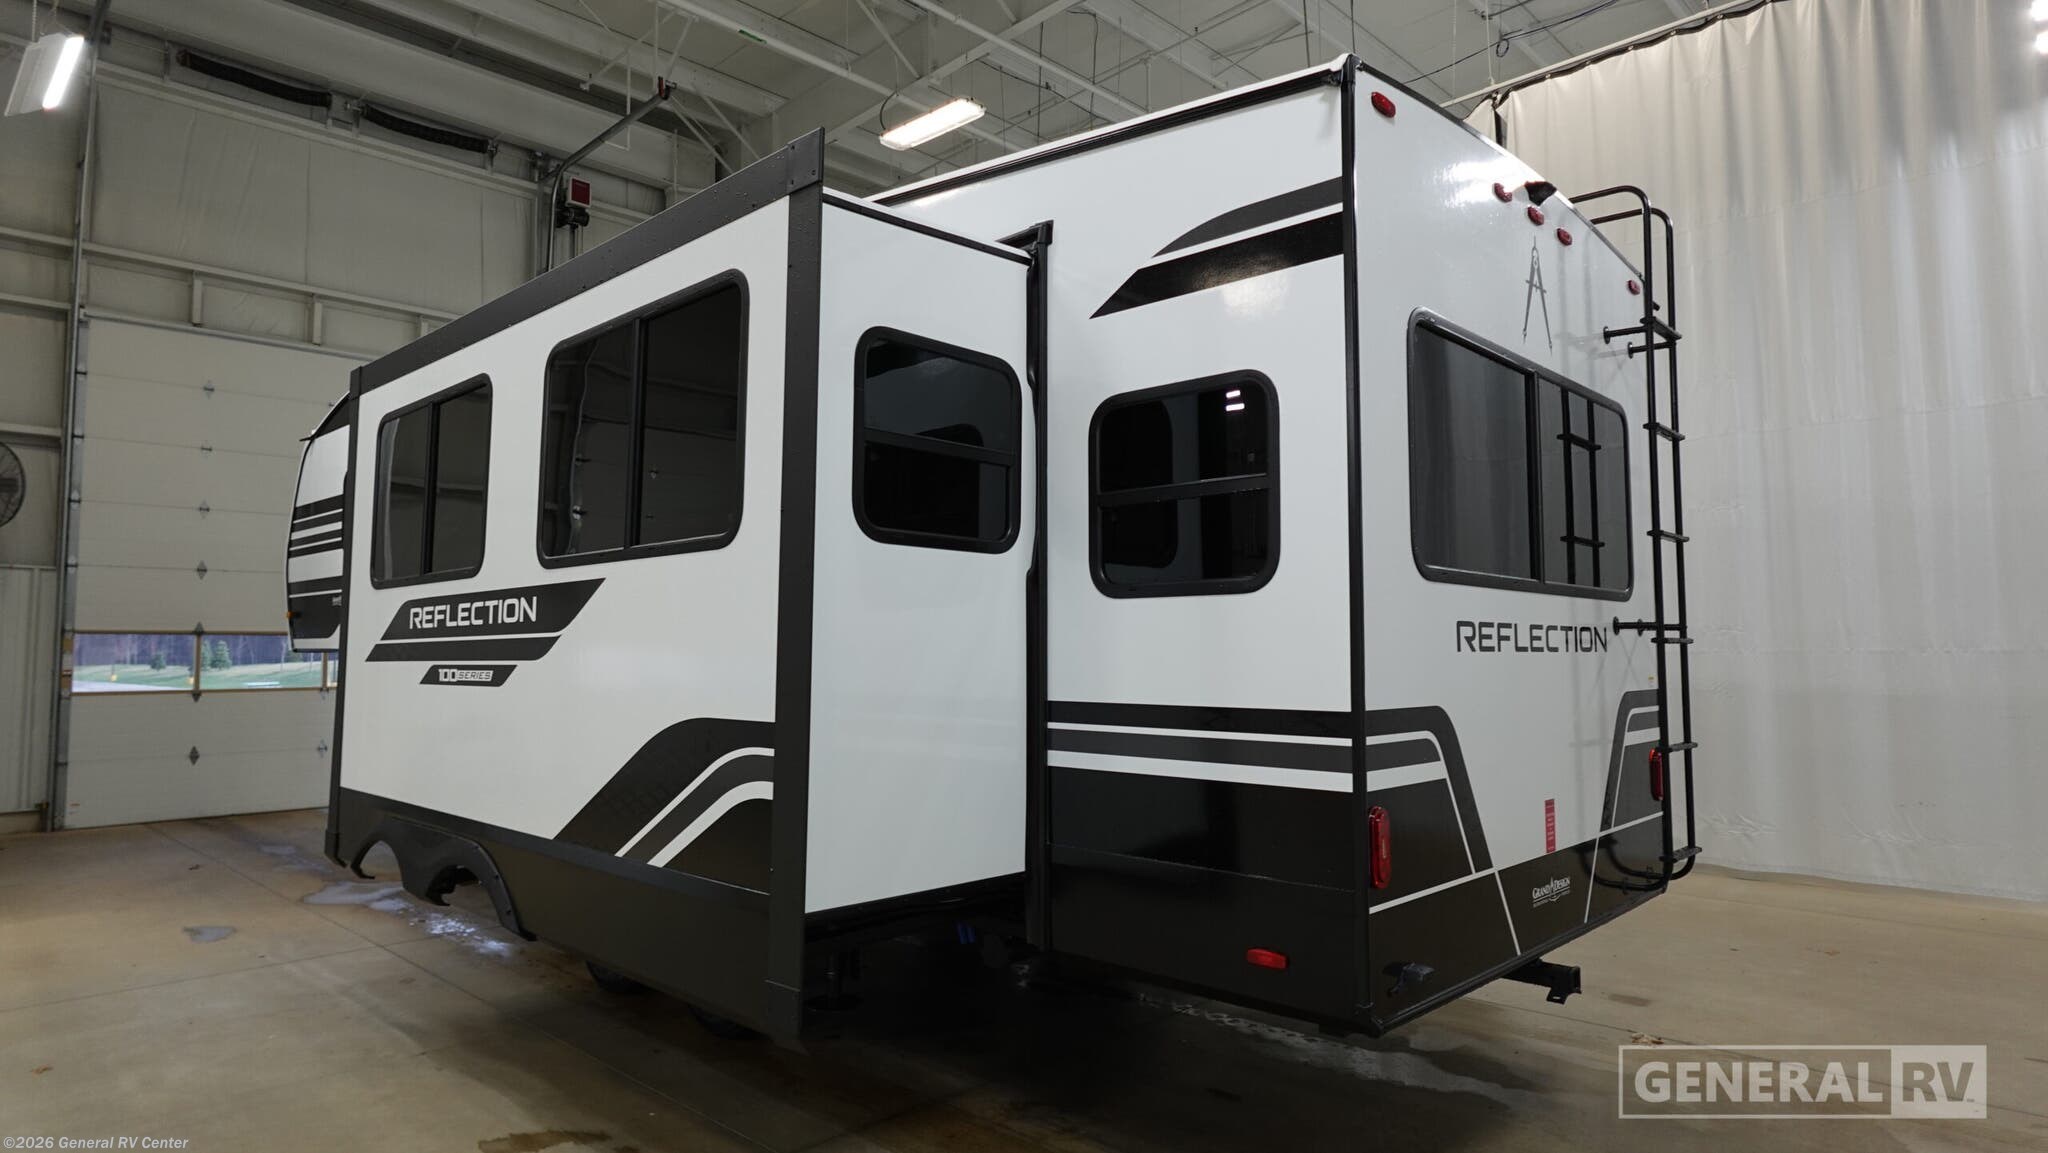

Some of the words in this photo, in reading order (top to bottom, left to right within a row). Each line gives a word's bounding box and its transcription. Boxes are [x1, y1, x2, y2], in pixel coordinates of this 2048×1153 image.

[409, 596, 537, 630] REFLECTION
[1456, 620, 1608, 653] REFLECTION
[438, 668, 458, 682] 100
[458, 670, 492, 681] SERIES
